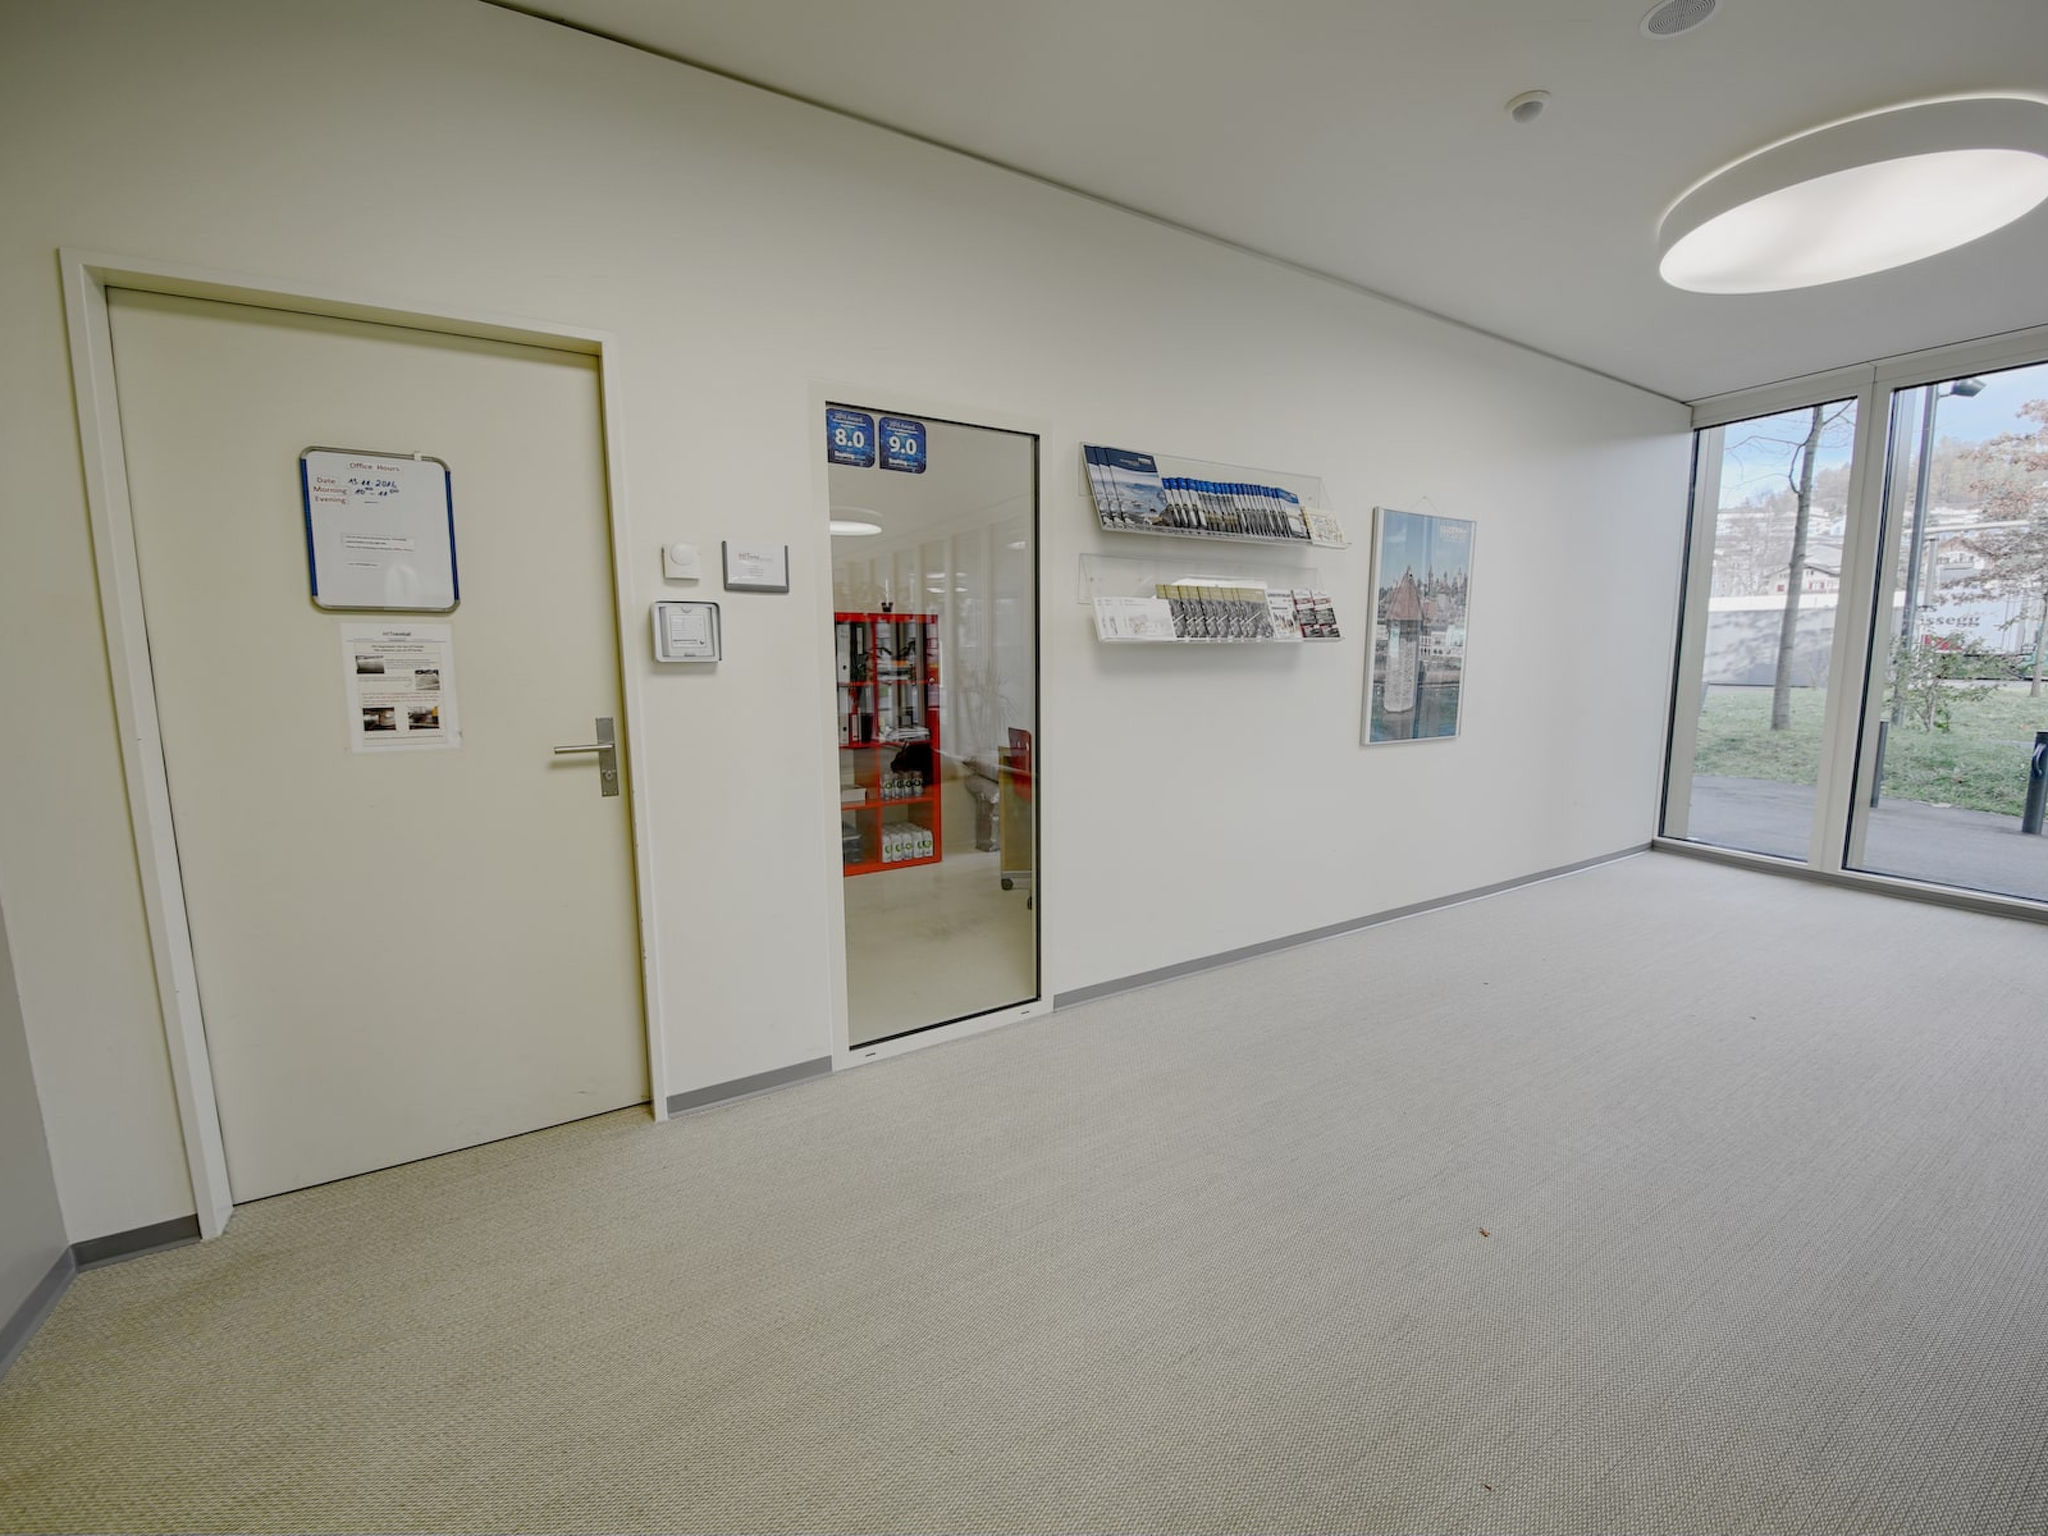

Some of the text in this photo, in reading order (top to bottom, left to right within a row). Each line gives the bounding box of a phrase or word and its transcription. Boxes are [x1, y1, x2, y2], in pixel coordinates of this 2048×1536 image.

[834, 428, 865, 448] 8.0
[889, 436, 917, 456] 9.0
[349, 462, 373, 470] Office
